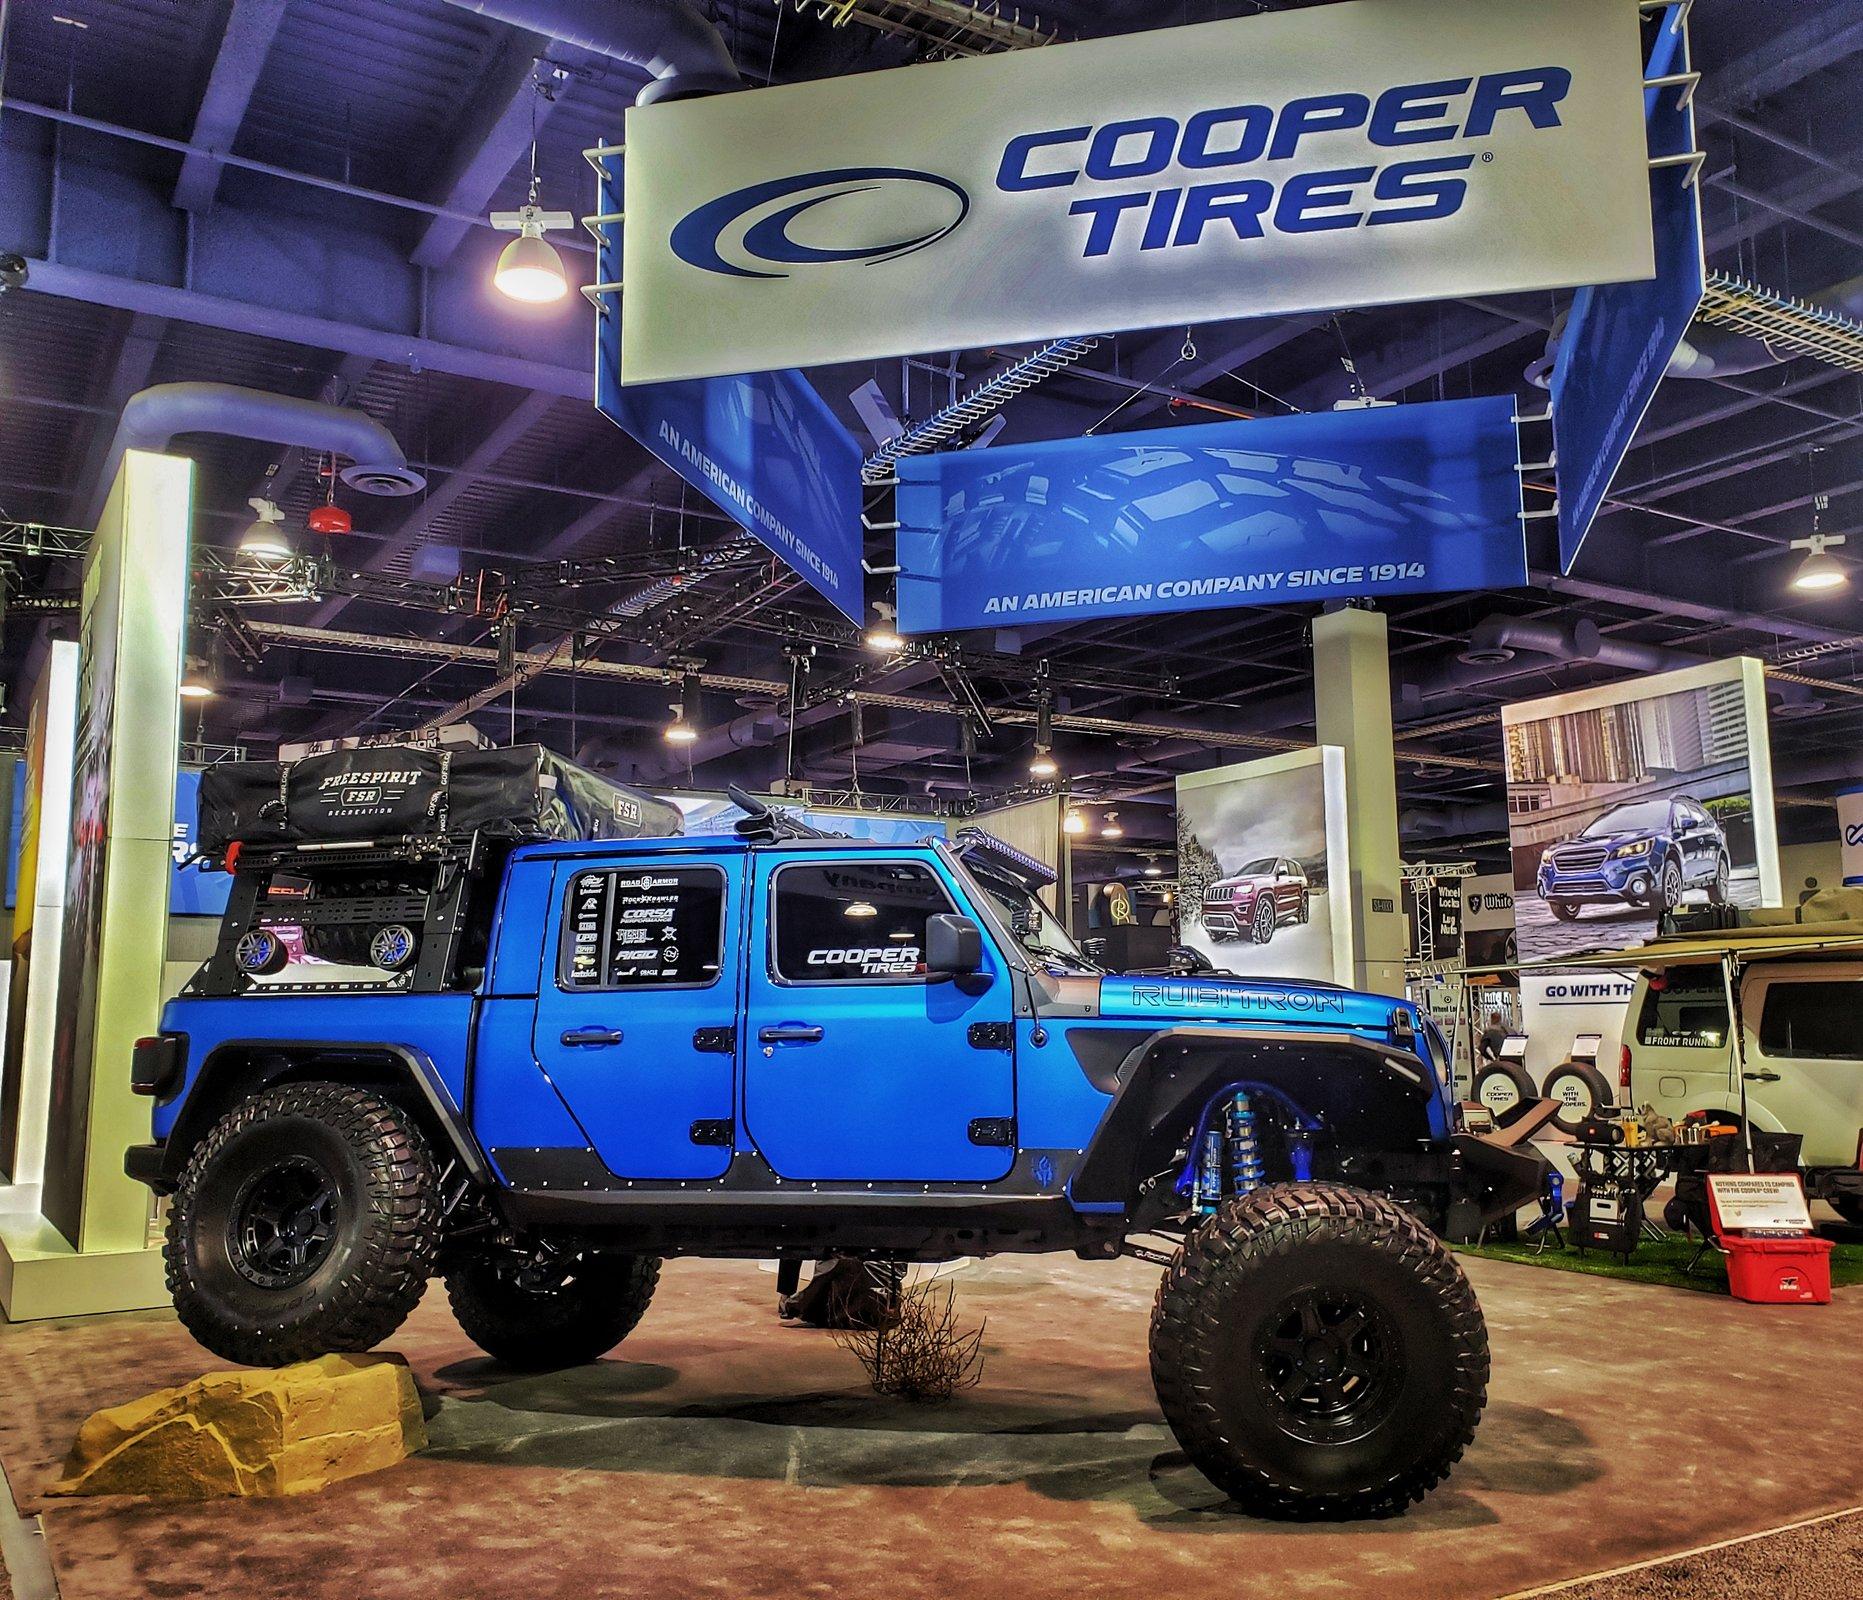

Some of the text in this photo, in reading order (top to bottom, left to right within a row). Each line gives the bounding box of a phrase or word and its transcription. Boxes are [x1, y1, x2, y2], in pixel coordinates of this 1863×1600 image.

[996, 67, 1572, 192] COOPER
[658, 419, 839, 590] AN AMERICAN COMPANY SINCE 1914
[983, 562, 1426, 614] AN AMERICAN COMPANY SINCE 1914
[318, 771, 422, 790] FREESPIRIT
[346, 790, 377, 802] FSR
[327, 807, 393, 817] RECREATION
[616, 799, 638, 820] FSR
[620, 877, 679, 888] ROAD ARMOR
[1438, 886, 1461, 898] Wheel
[1439, 898, 1460, 908] Locks
[1484, 893, 1513, 911] White
[622, 908, 676, 919] CORSA
[615, 949, 659, 961] RIGID
[807, 947, 920, 965] COOPER
[860, 962, 918, 974] TIRES
[1546, 984, 1633, 998] GO WITH TH
[1652, 1036, 1680, 1046] FRONT
